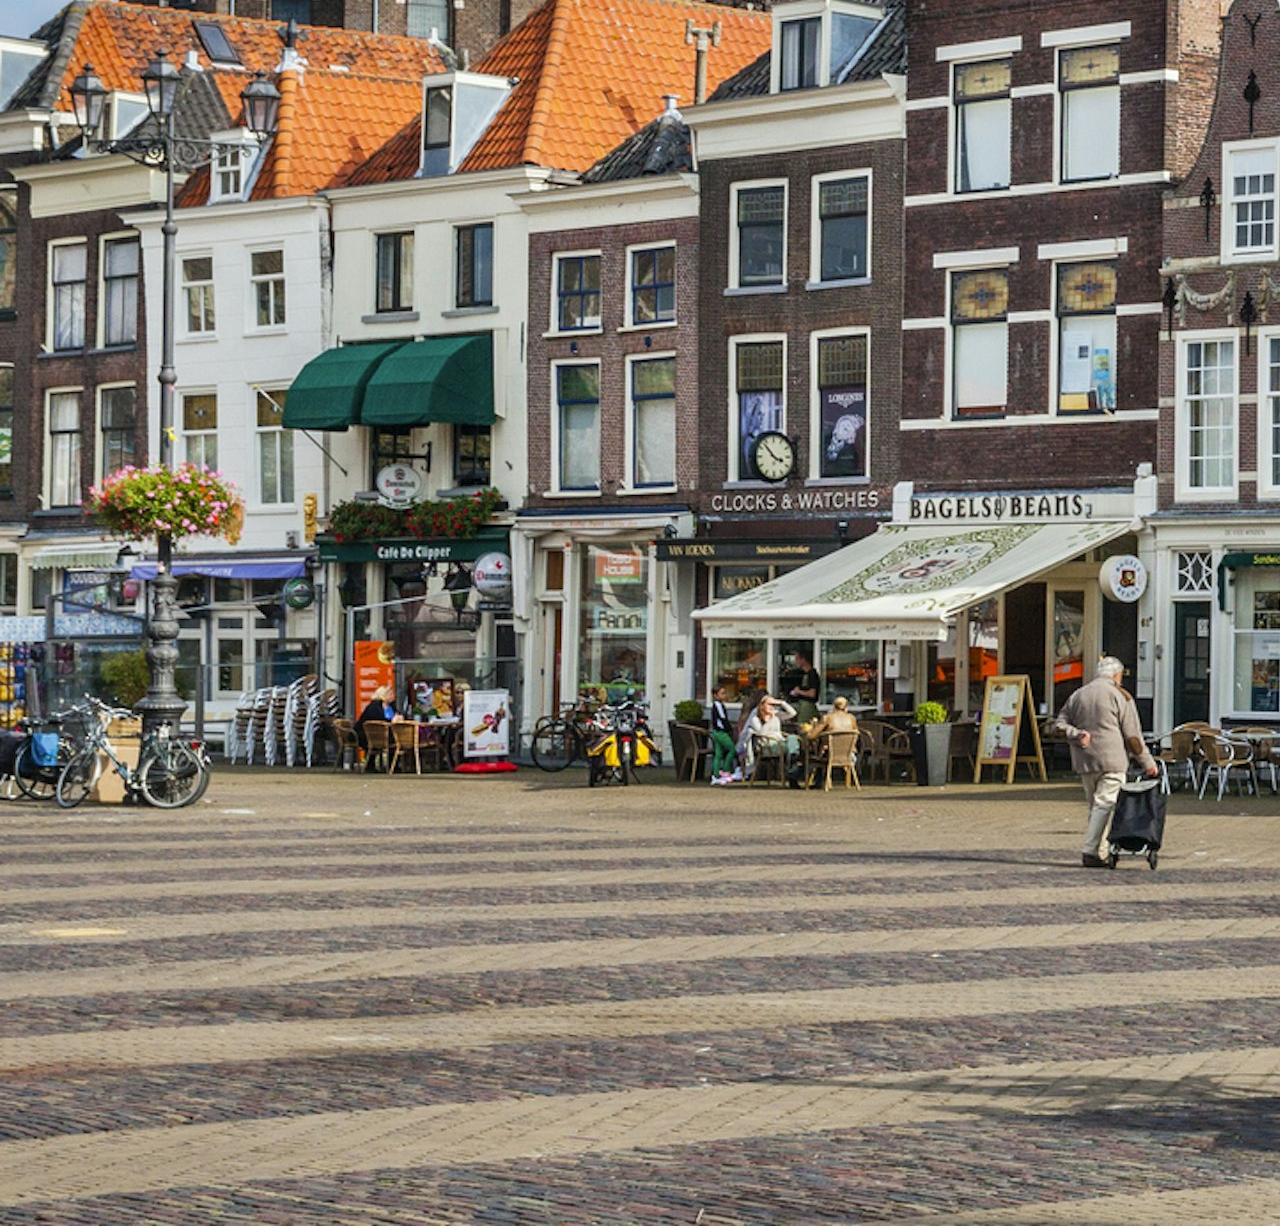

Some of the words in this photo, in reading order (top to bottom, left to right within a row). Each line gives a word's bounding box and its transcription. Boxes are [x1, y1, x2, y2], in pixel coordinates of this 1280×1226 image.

[828, 392, 864, 403] LONGINES
[711, 495, 777, 511] CLOCKS
[782, 493, 795, 510] &
[798, 491, 879, 509] WATCHES
[910, 497, 991, 519] BAGELS
[1010, 494, 1083, 517] BEANS
[400, 546, 414, 559] De
[415, 545, 452, 561] Clipper
[668, 544, 684, 556] VAN
